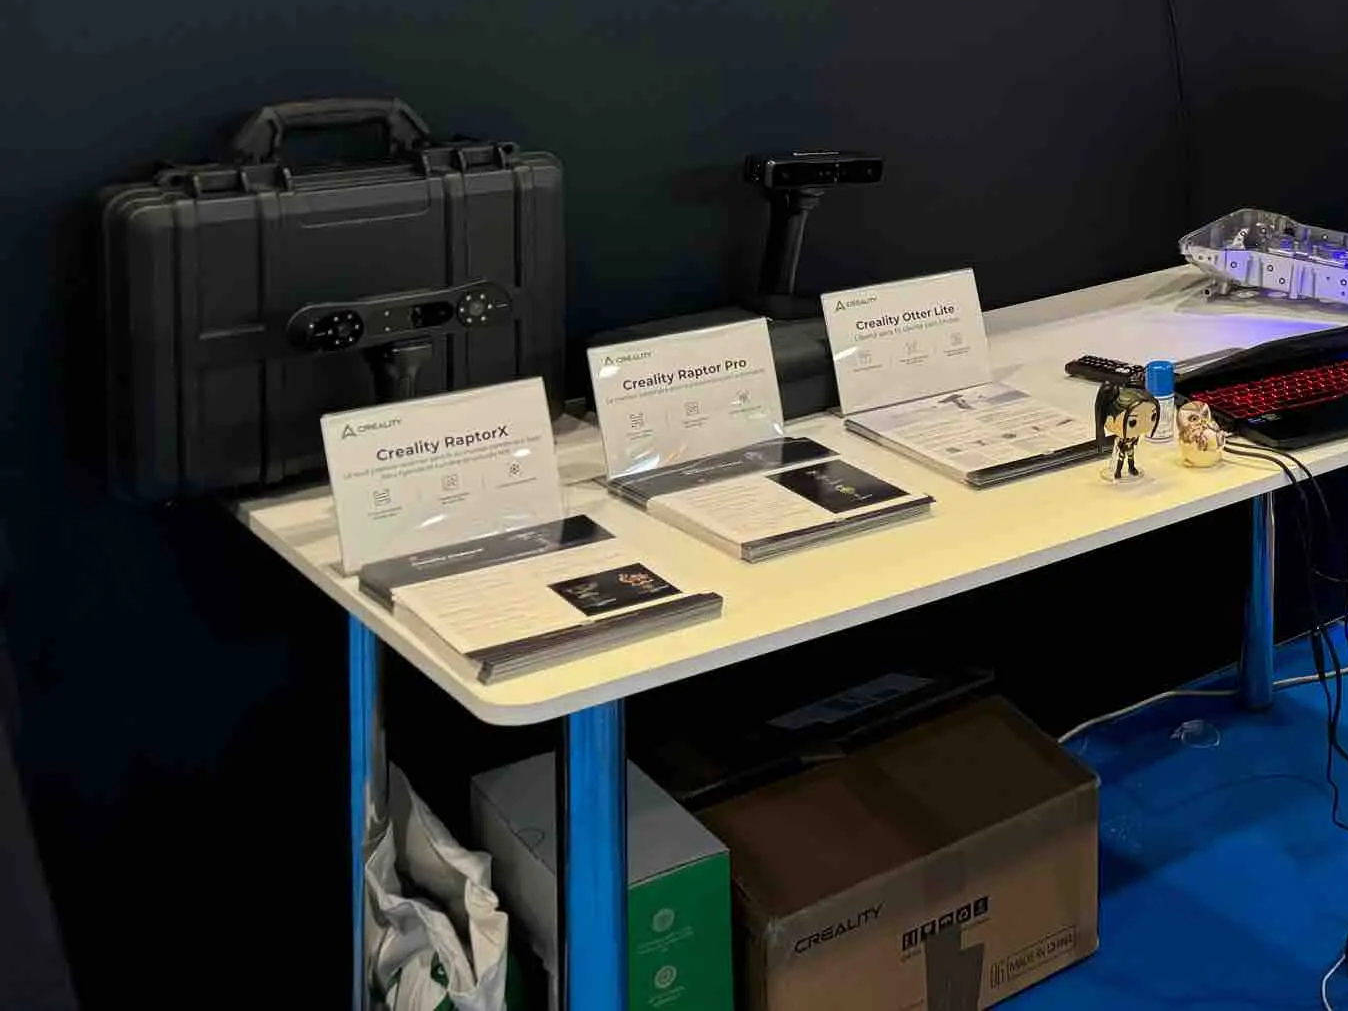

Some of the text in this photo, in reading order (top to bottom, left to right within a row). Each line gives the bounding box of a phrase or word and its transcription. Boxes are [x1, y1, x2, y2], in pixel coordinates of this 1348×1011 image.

[855, 314, 900, 332] Creality
[902, 309, 932, 323] Otter
[934, 303, 955, 317] Lite
[622, 370, 675, 391] Creality
[678, 363, 722, 381] Raptor
[724, 358, 747, 372] Pro
[376, 439, 440, 462] Creality
[444, 425, 510, 448] RaptorX
[794, 902, 884, 955] CREALITY
